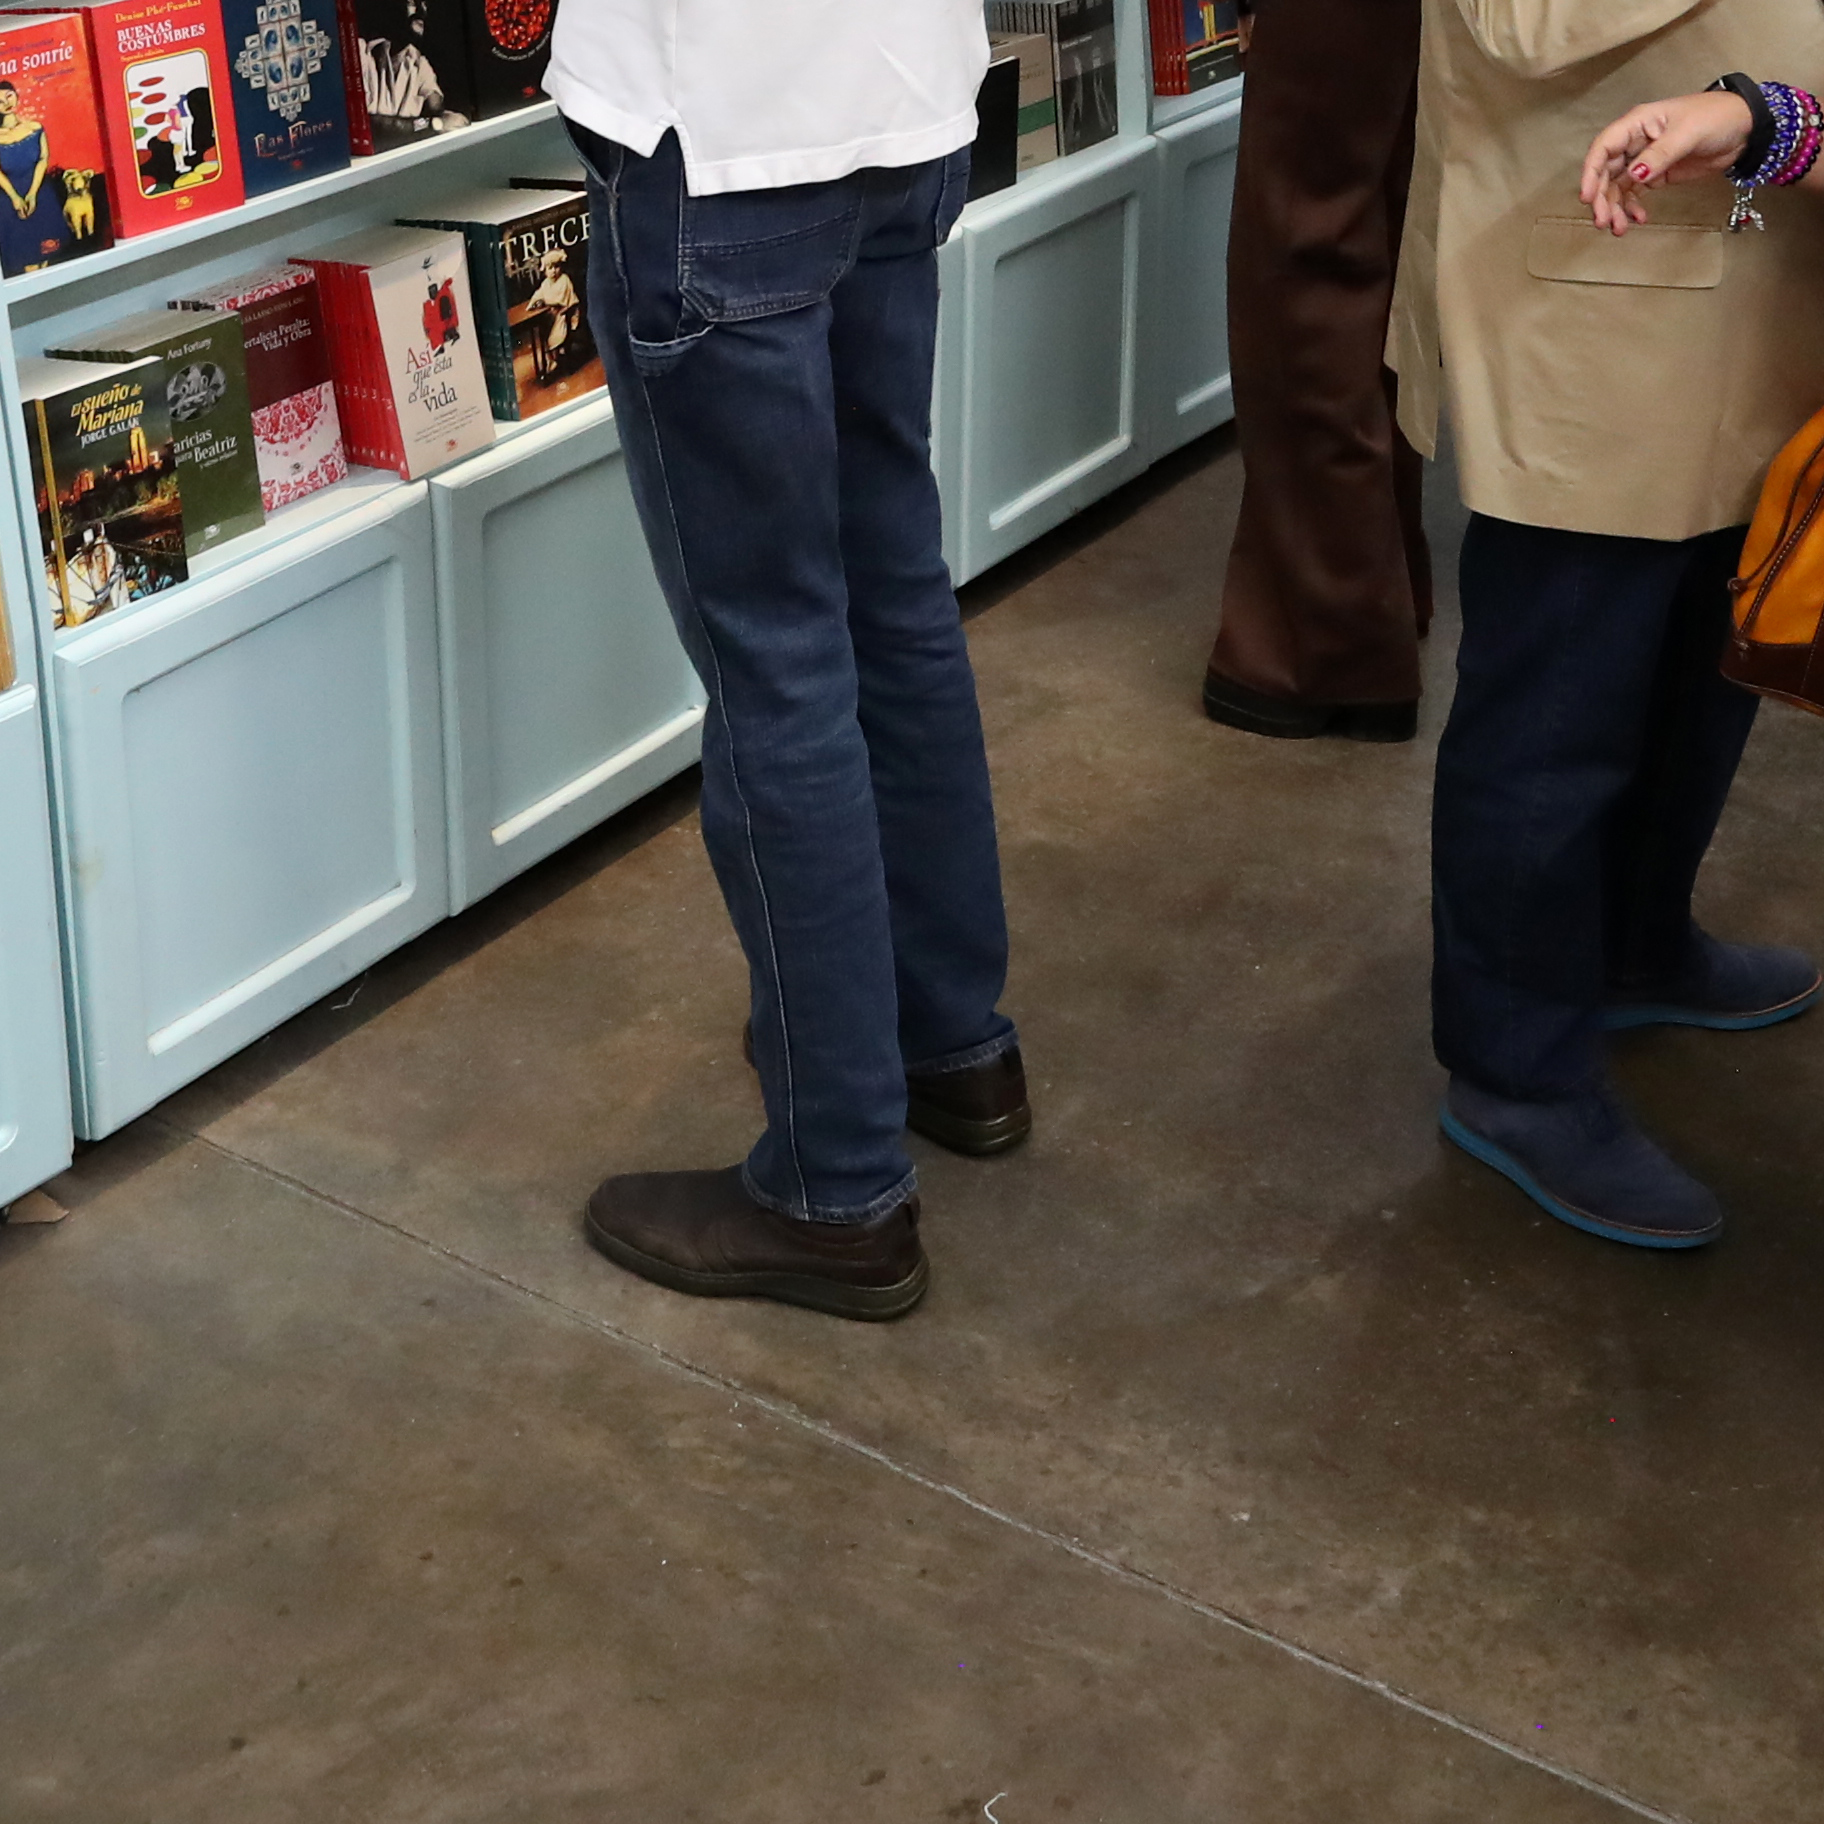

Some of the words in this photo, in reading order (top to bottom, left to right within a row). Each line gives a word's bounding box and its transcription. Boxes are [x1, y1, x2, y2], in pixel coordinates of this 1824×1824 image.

[116, 19, 173, 43] BUENAS
[117, 21, 206, 54] COSTUMBRES
[423, 382, 458, 412] vida
[81, 429, 107, 448] JORGE
[109, 418, 140, 437] GALÁN
